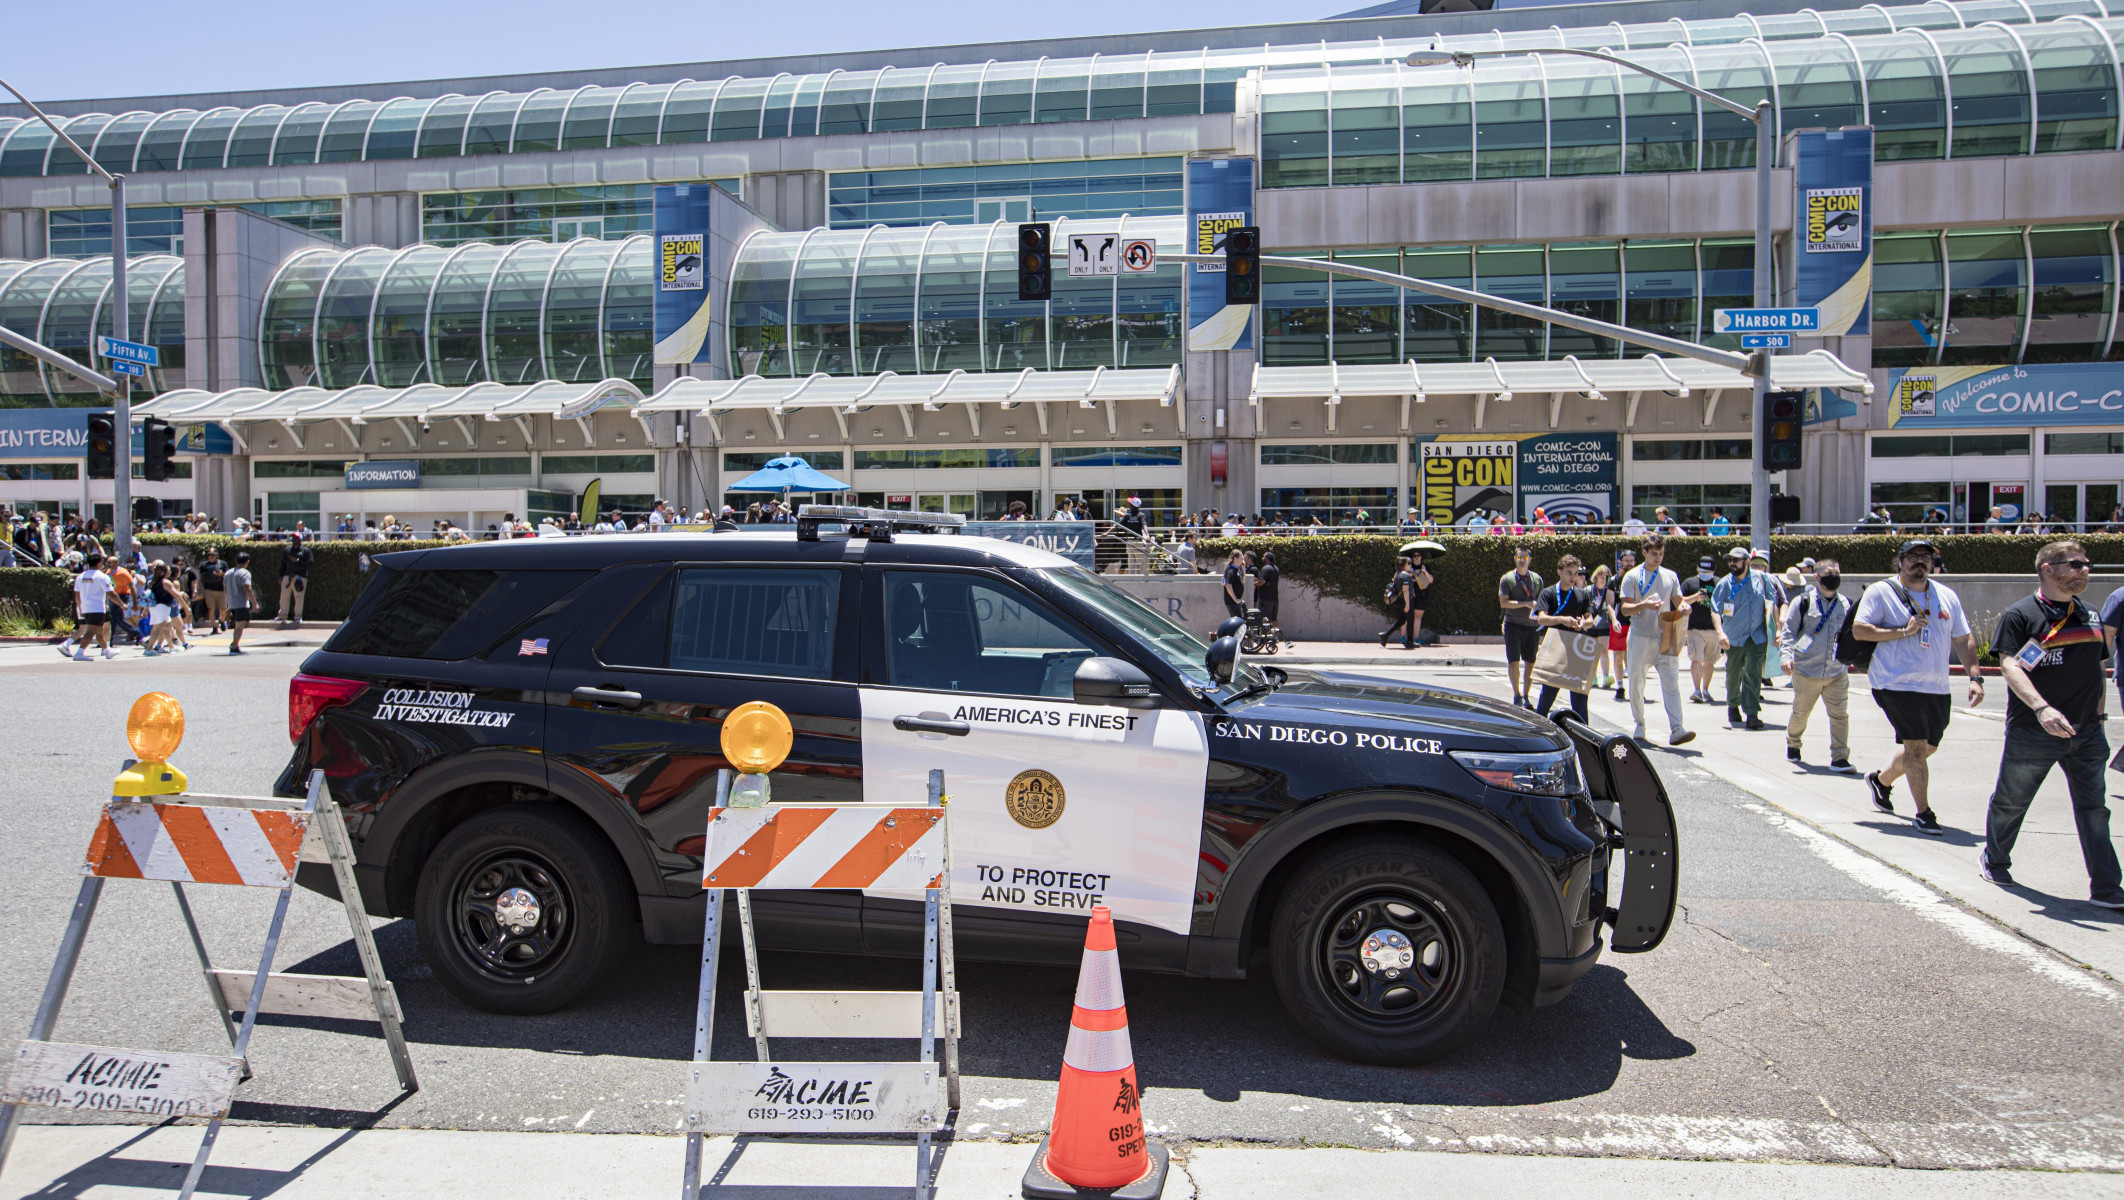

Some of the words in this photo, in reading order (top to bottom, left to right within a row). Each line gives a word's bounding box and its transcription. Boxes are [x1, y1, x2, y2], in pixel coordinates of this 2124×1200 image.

[1826, 195, 1859, 212] CON
[1214, 219, 1242, 234] CON
[1808, 197, 1826, 243] COMIC
[1199, 220, 1214, 254] OMIC
[1807, 241, 1859, 251] INTERNATIONAL
[676, 240, 701, 255] CON
[663, 242, 676, 282] COMIC
[1075, 266, 1089, 274] ONLY
[1099, 265, 1113, 273] ONLY
[1198, 263, 1226, 271] INTERNAT
[662, 281, 702, 289] INTERNATIONAL
[1735, 313, 1787, 328] HARBOR
[1792, 312, 1815, 327] DR.
[1766, 336, 1784, 347] 500
[112, 342, 136, 358] FIFTH
[137, 347, 151, 361] AV.
[1912, 380, 1934, 391] CON
[1942, 372, 2011, 414] Welcome
[2013, 365, 2028, 379] to
[1901, 381, 1913, 411] COMIC
[0, 428, 89, 448] INTERNA
[1535, 441, 1602, 452] COMIC-CON
[1424, 446, 1452, 456] SAN
[1466, 445, 1513, 456] DIEGO
[1523, 452, 1614, 463] INTERNATIONAL
[349, 469, 417, 483] INFORMATION
[1456, 457, 1512, 486] CON
[1537, 464, 1560, 474] SAN
[1563, 463, 1600, 474] DIEGO
[1520, 483, 1612, 493] WWW.COMIC-CON.ORG
[1025, 534, 1080, 554] ONLY
[383, 688, 476, 709] COLLISION
[373, 704, 516, 728] INVESTIGATION
[953, 705, 1061, 726] AMERICA'S
[1068, 712, 1139, 731] FINEST
[1215, 722, 1262, 740] SAN
[1269, 725, 1348, 746] DIEGO
[1355, 732, 1444, 755] POLICE
[976, 865, 1004, 883] TO
[1012, 868, 1111, 891] PROTECT
[981, 885, 1026, 904] AND
[1033, 889, 1103, 910] SERVE
[66, 1052, 170, 1090] ACME
[771, 1078, 873, 1105] ACME
